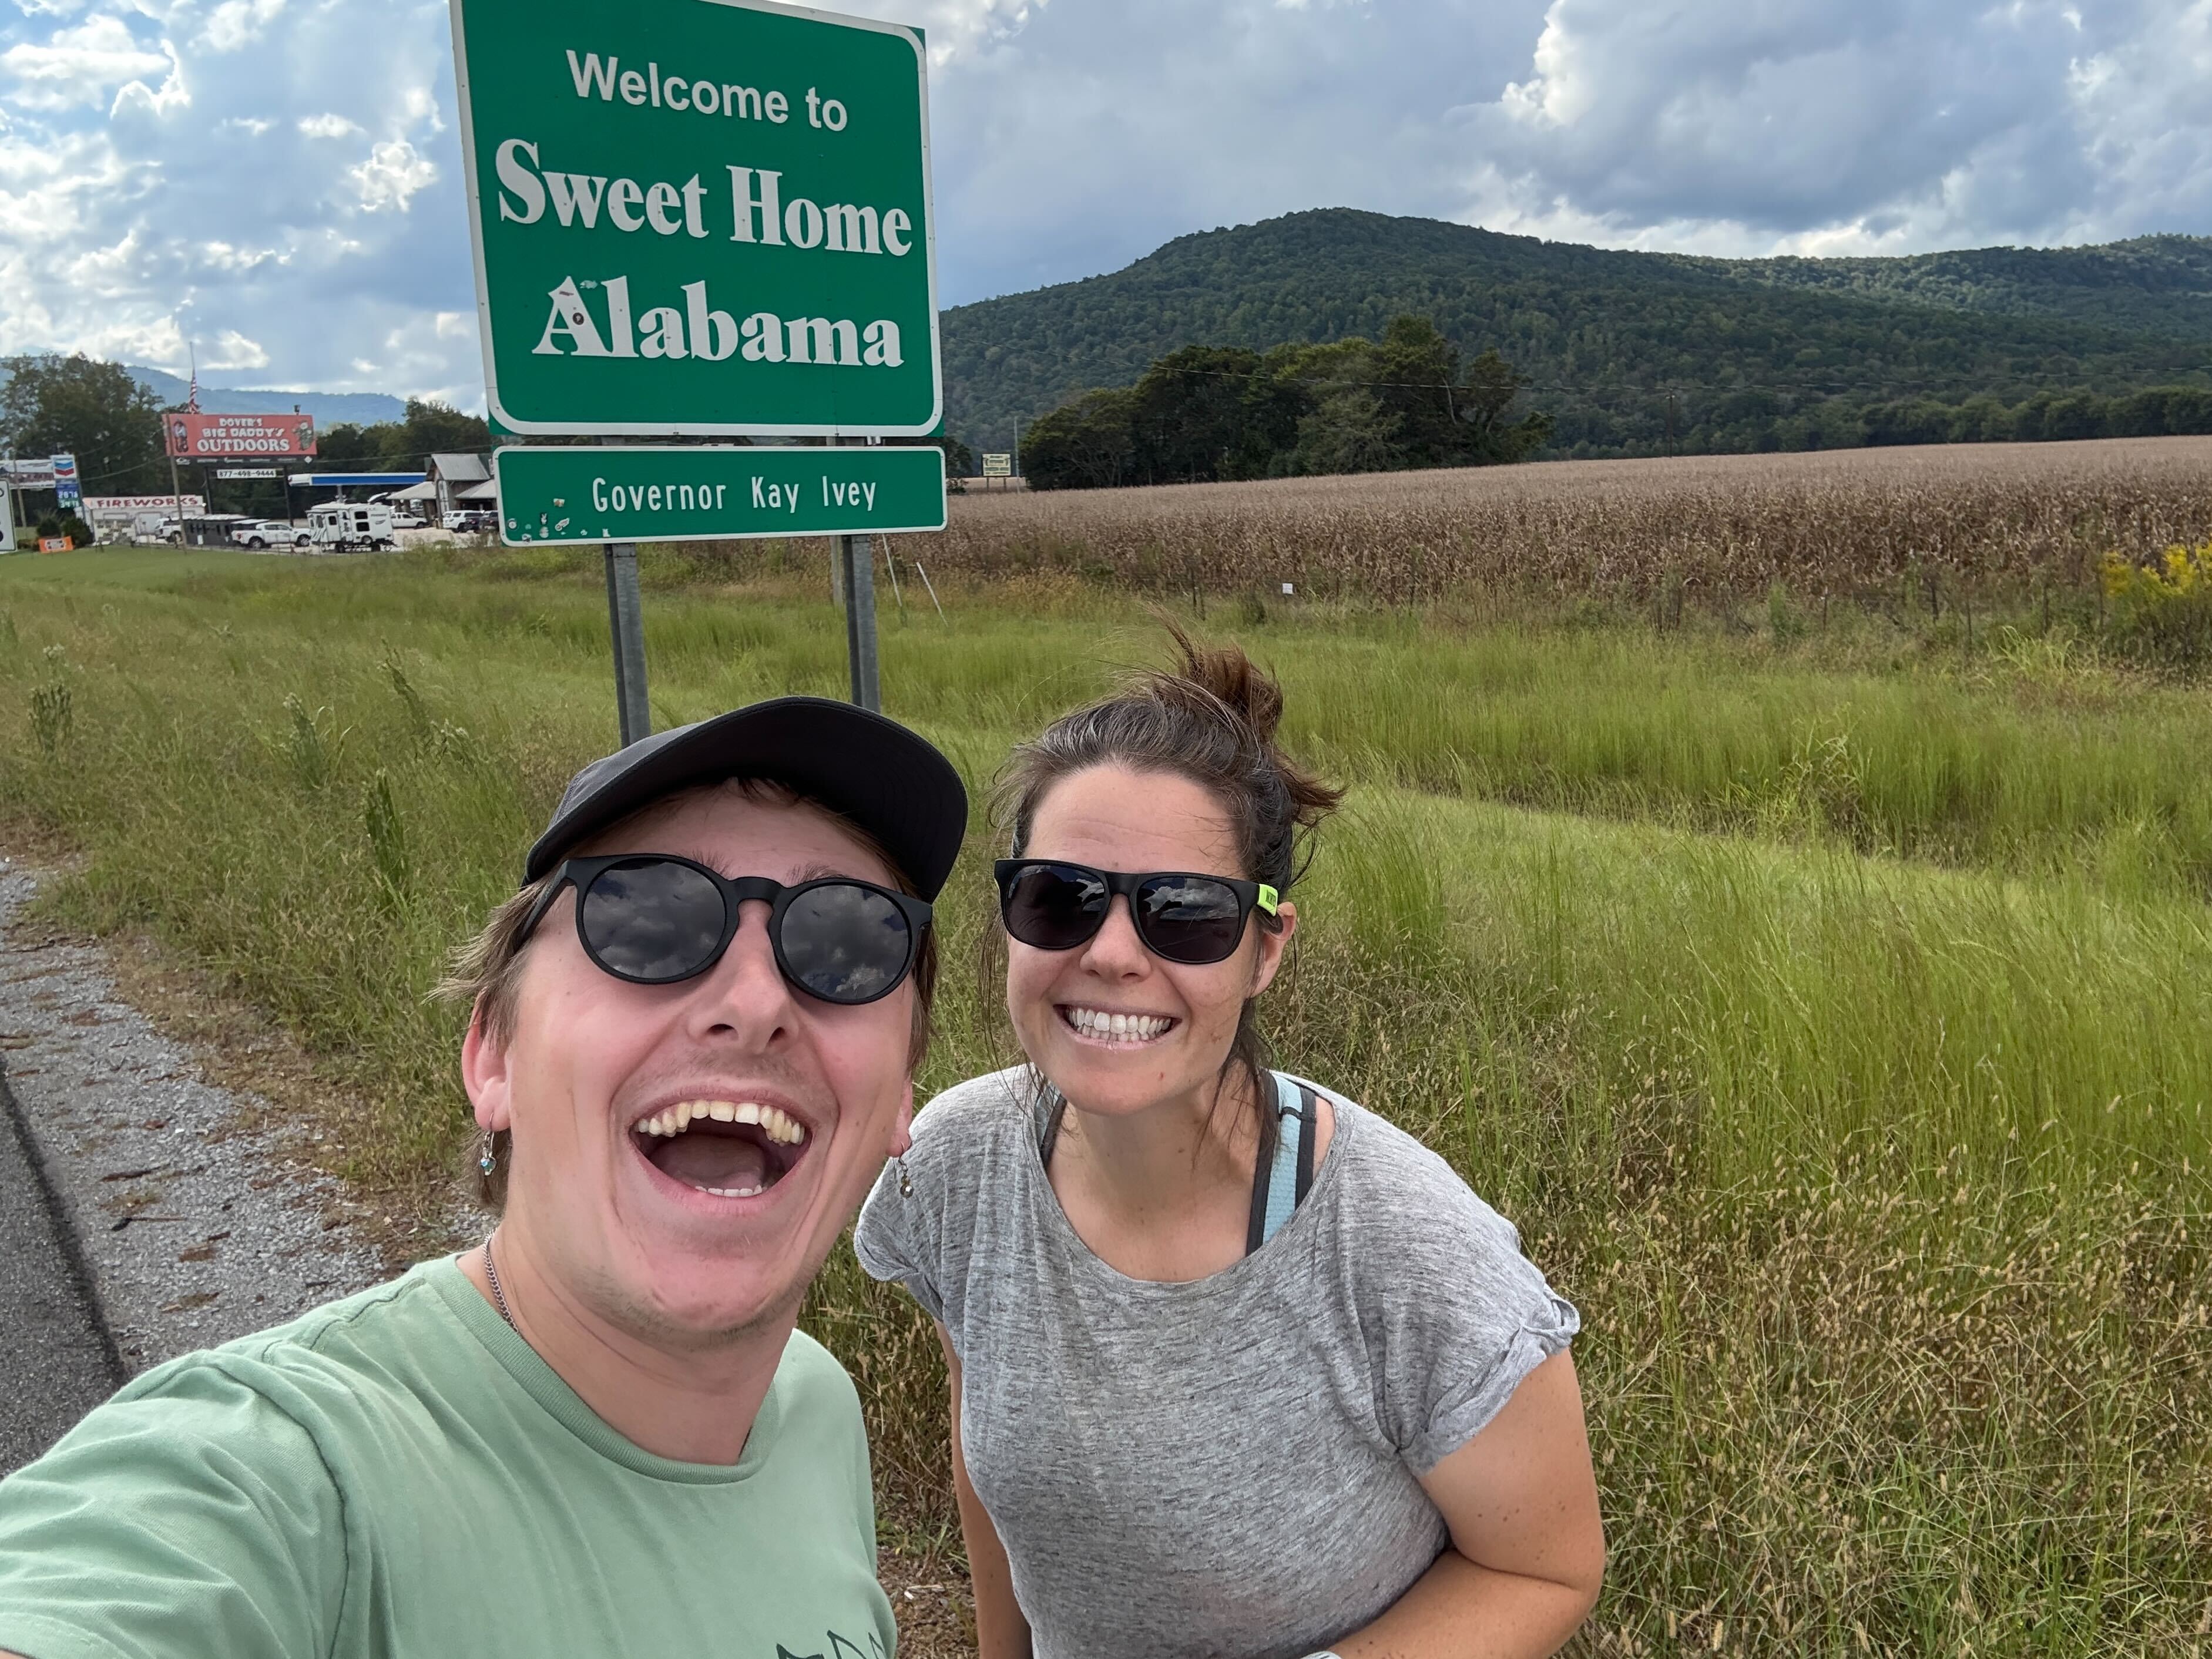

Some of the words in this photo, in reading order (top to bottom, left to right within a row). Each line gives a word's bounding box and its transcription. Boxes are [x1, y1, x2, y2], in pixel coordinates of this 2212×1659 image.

[566, 49, 788, 123] Welcome
[805, 87, 847, 131] to
[496, 139, 709, 238] Sweet
[726, 165, 912, 256] Home
[532, 276, 904, 367] Alabama
[202, 428, 226, 438] BIG
[230, 428, 284, 438] DADDY'S
[219, 418, 263, 427] DOVER'S
[197, 439, 290, 452] OUTDOORS
[593, 478, 726, 512] Governor
[751, 476, 799, 513] Kay
[823, 476, 875, 511] Ivey
